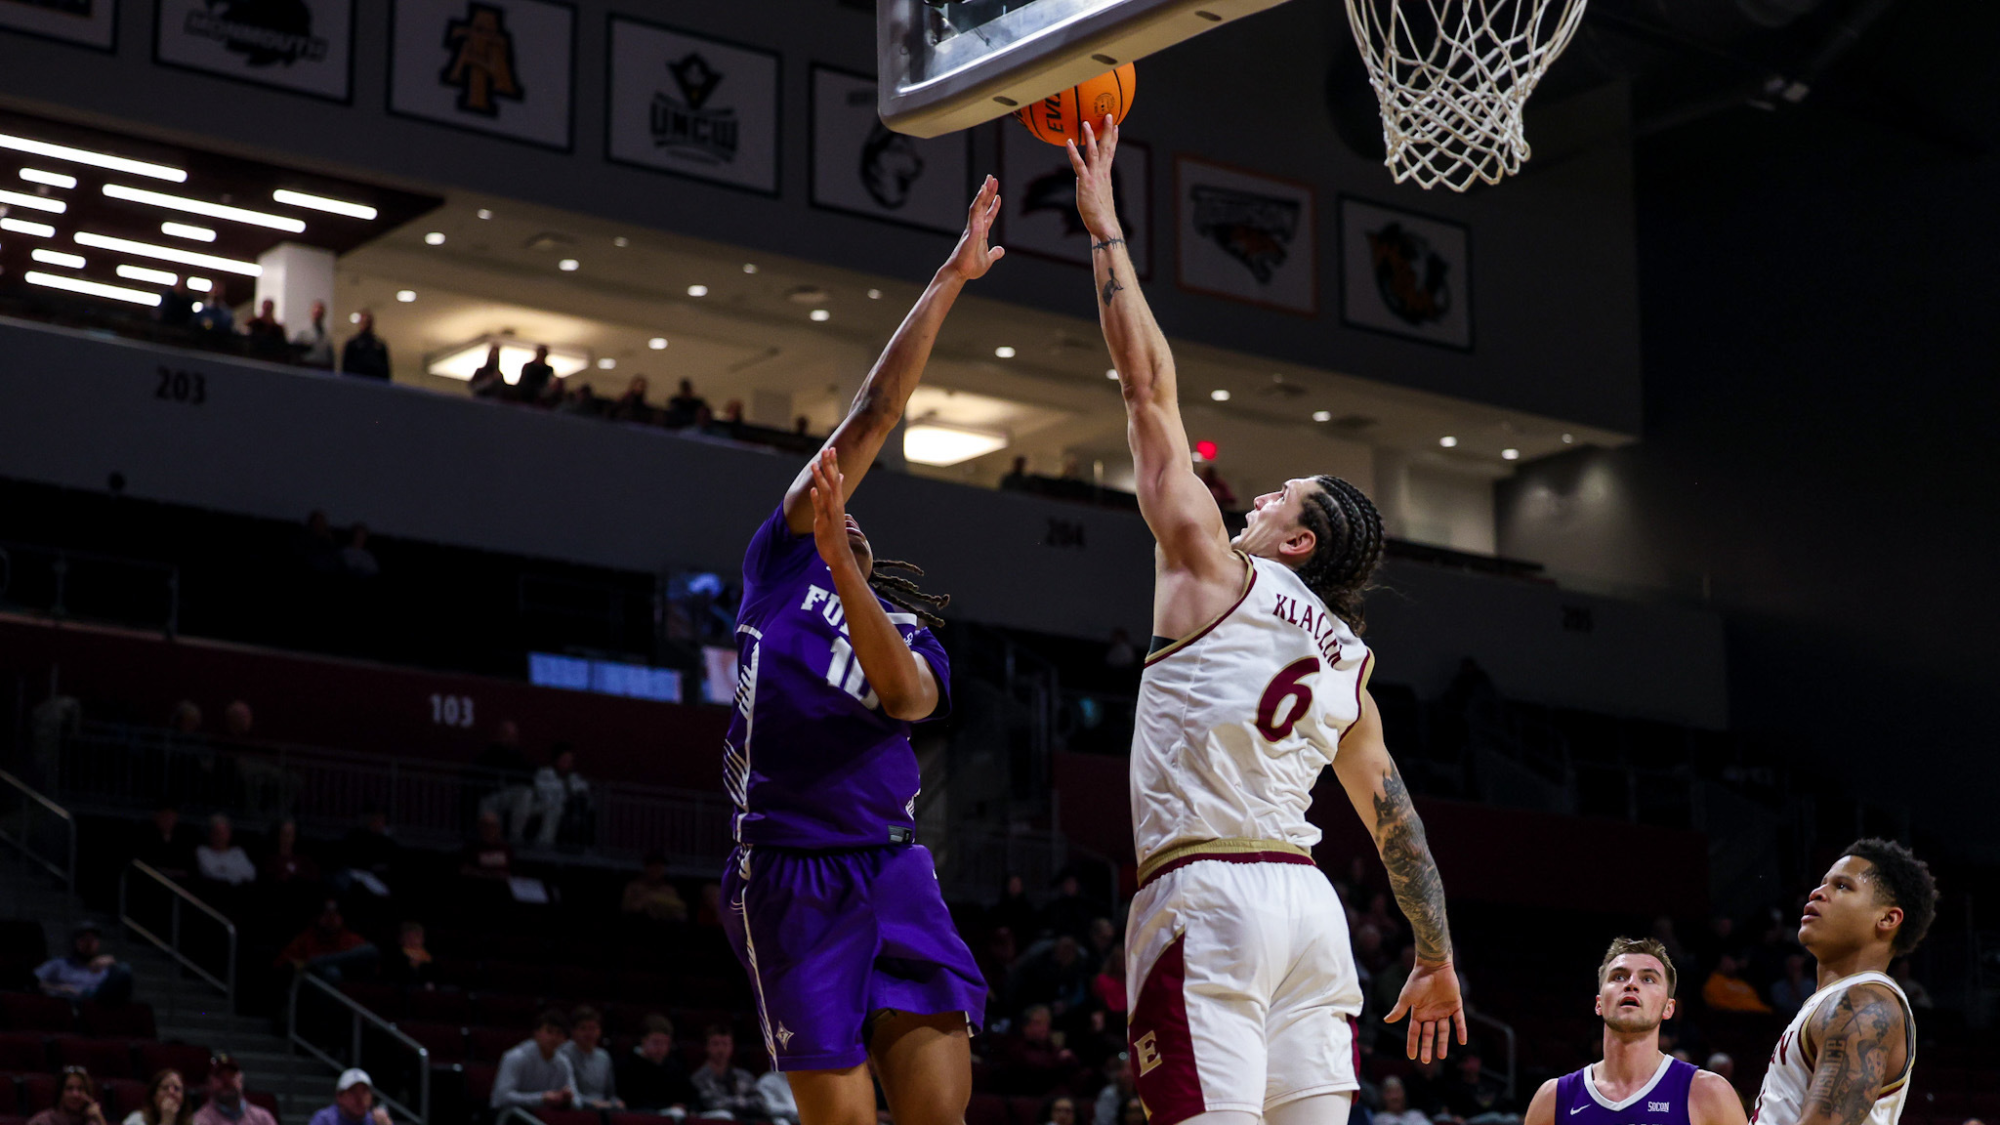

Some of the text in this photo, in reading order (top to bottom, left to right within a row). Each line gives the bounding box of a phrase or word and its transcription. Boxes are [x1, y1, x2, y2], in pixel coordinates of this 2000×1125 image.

[651, 102, 738, 151] UNCW
[156, 366, 205, 405] 203
[1046, 517, 1085, 549] 204
[428, 692, 474, 729] 103
[1256, 657, 1320, 743] 6
[1133, 1030, 1163, 1077] E
[1647, 1101, 1669, 1113] SOCON
